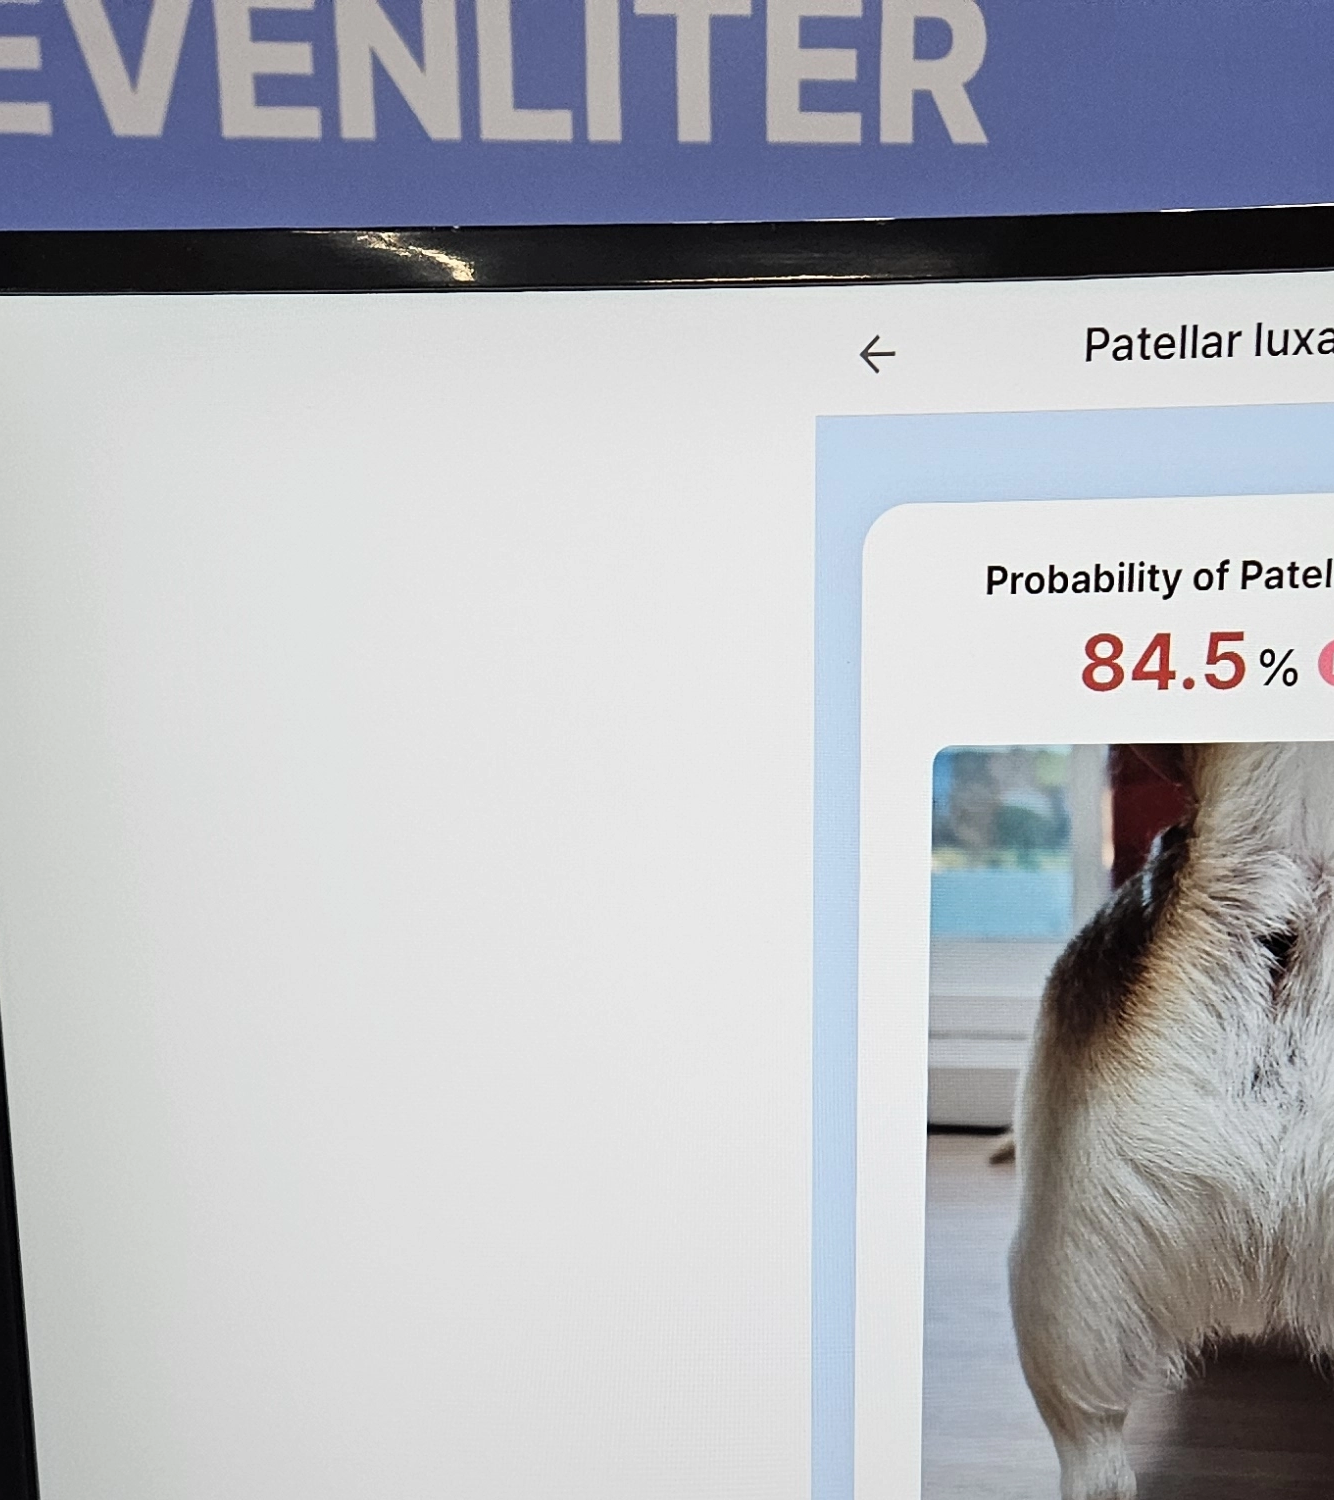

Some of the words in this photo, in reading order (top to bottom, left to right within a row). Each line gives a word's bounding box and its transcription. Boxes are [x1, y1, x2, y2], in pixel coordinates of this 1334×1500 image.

[1083, 324, 1244, 366] Patellar
[984, 559, 1183, 602] Probability
[1192, 556, 1231, 594] of
[1081, 630, 1248, 694] 84.5
[1259, 646, 1301, 688] %
